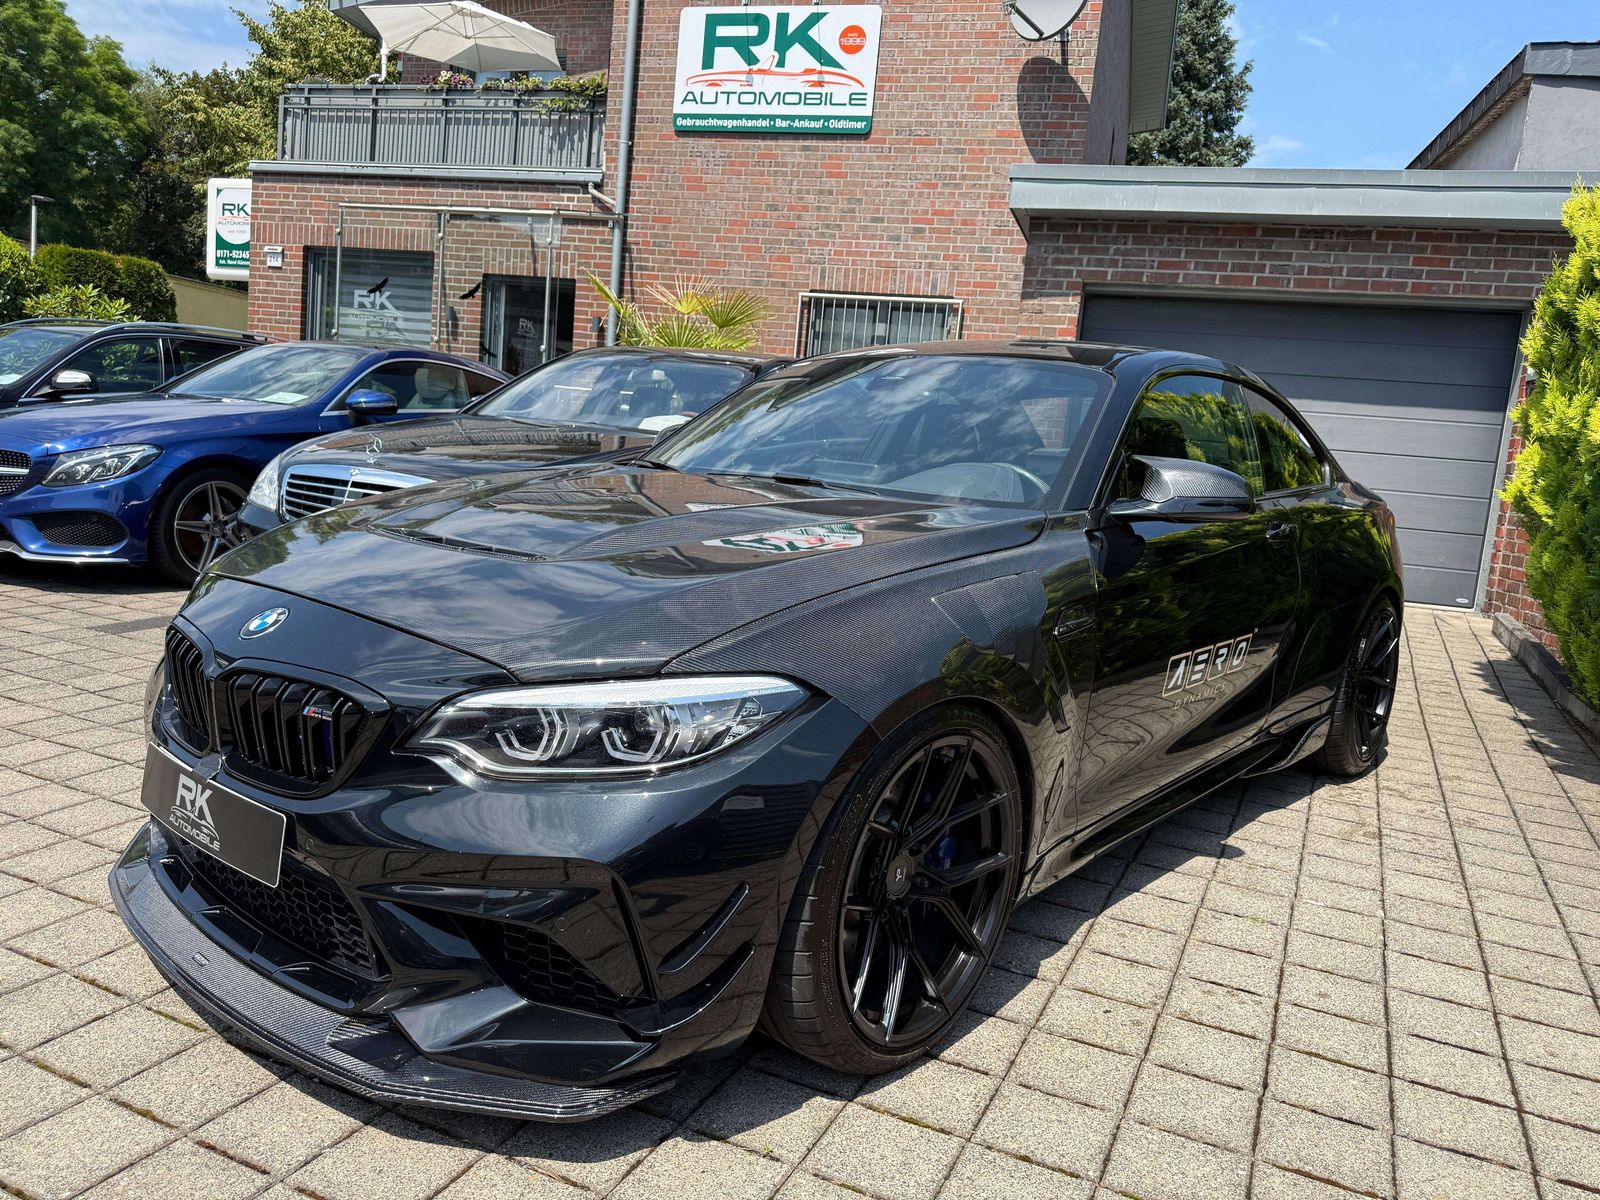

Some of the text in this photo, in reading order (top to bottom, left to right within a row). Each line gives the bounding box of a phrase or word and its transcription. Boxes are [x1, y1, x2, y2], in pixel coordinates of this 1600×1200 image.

[701, 12, 847, 71] RK
[840, 37, 866, 46] 1999
[680, 91, 868, 107] AUTOMOBILE
[676, 117, 867, 130] Gebrauchtwagenhandel Bar-Ankauf Oldtimer
[221, 203, 250, 217] RK
[353, 289, 397, 311] RK
[519, 317, 536, 331] RK
[1173, 682, 1226, 710] DYNAMICS
[175, 773, 215, 829] RK
[168, 813, 221, 851] AUTOMOBILE
